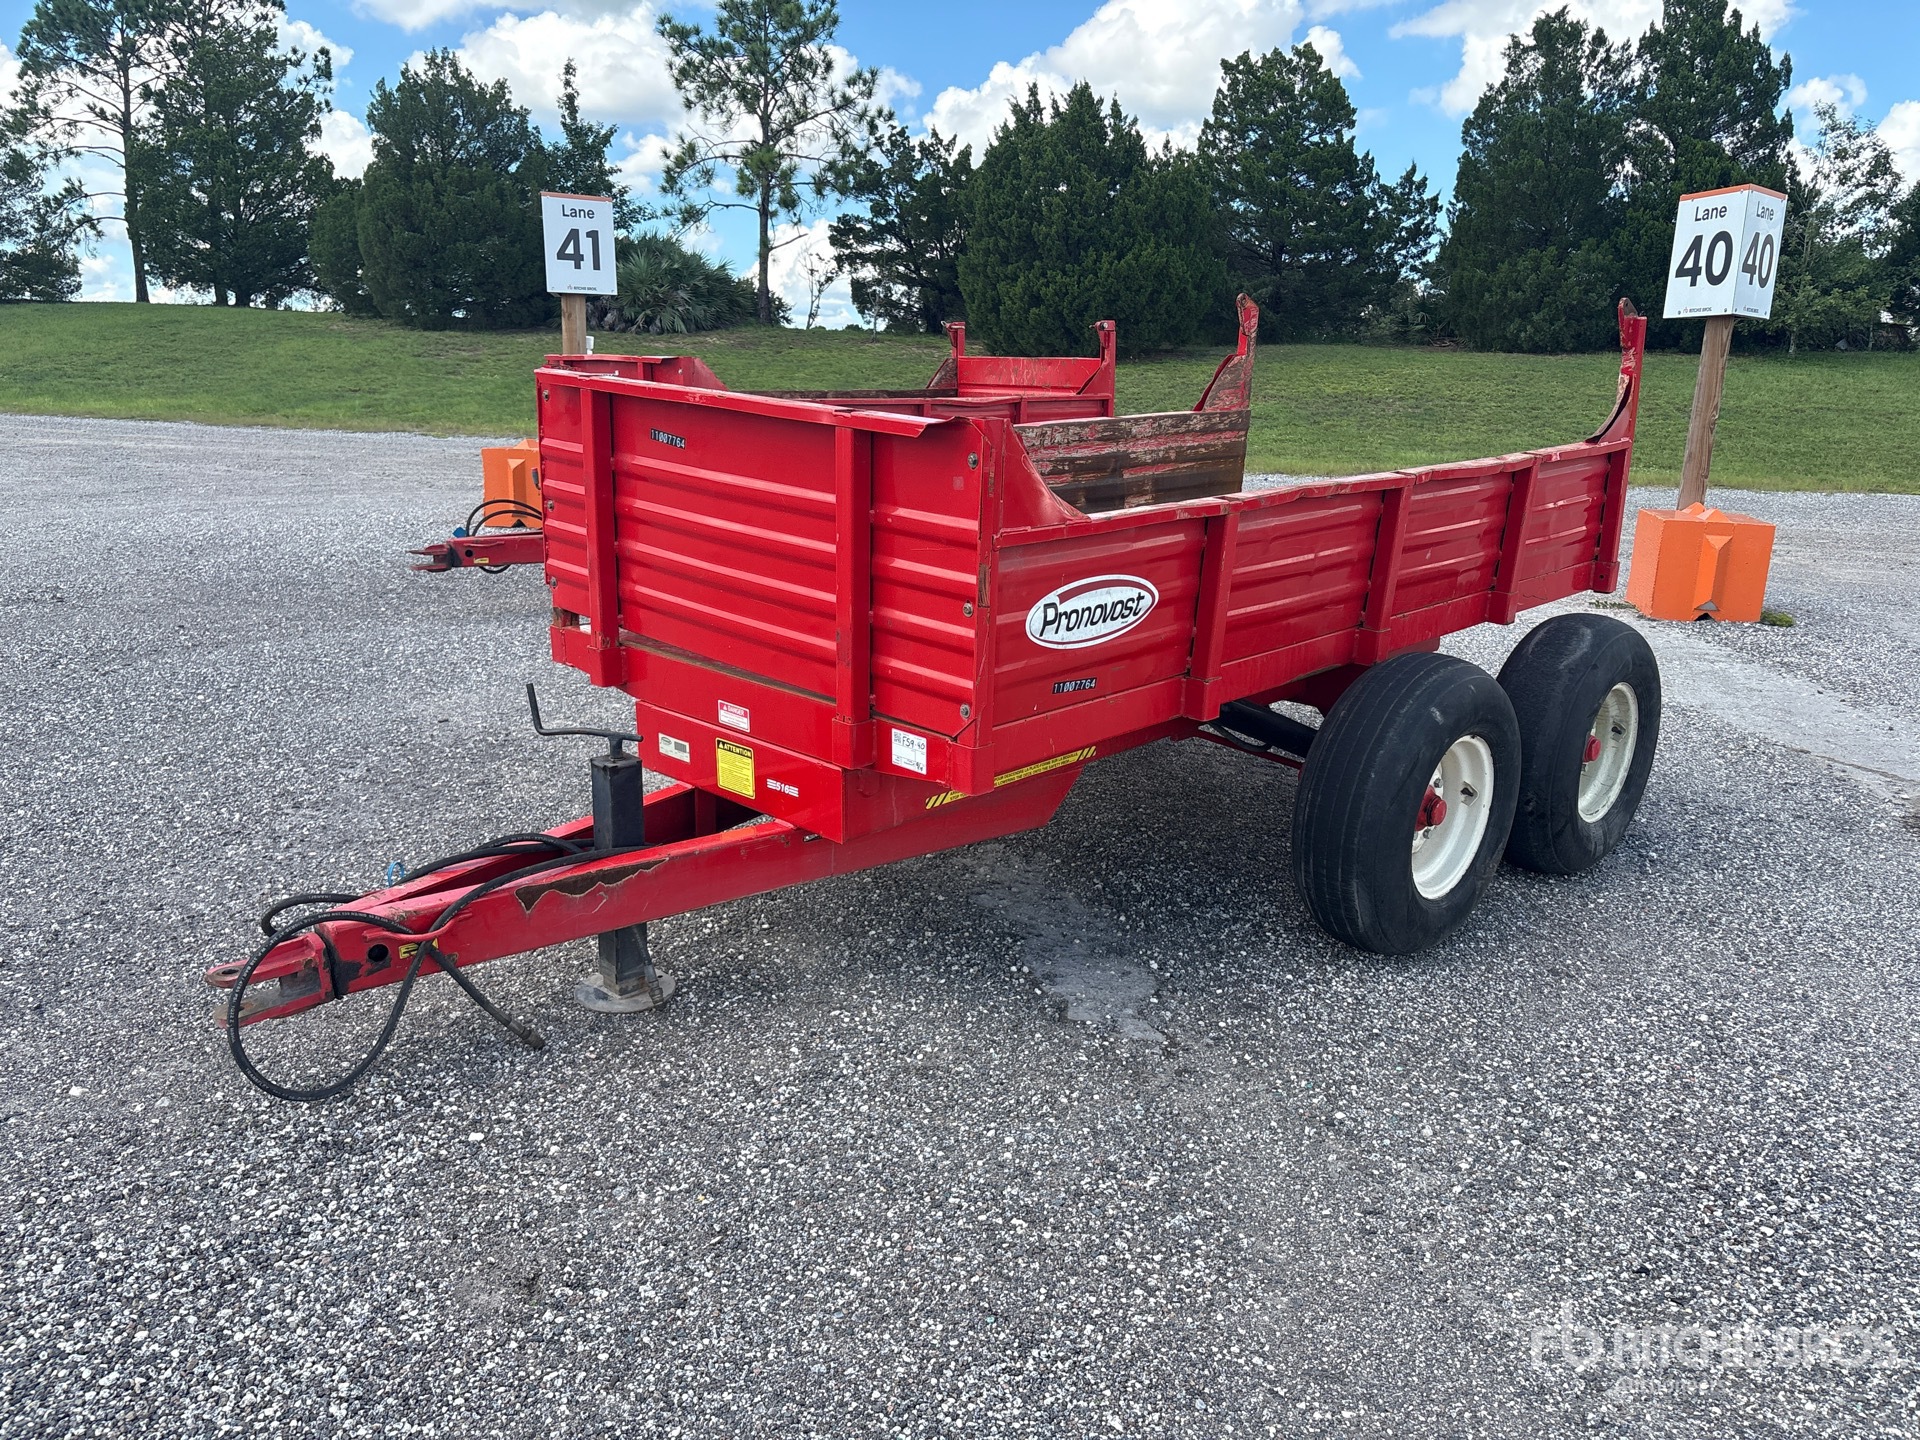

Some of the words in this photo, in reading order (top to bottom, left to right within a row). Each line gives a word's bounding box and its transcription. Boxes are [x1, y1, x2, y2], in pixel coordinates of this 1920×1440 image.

[562, 204, 595, 219] Lane
[1694, 205, 1727, 222] Lane
[1756, 201, 1774, 221] Lane
[556, 228, 601, 271] 41
[1675, 230, 1733, 287] 40
[1742, 231, 1774, 288] 40
[651, 429, 685, 449] 11007764
[1039, 592, 1145, 637] Pronovost
[1053, 678, 1096, 694] 11007764
[724, 743, 752, 757] ATTENTION
[776, 782, 789, 794] 516
